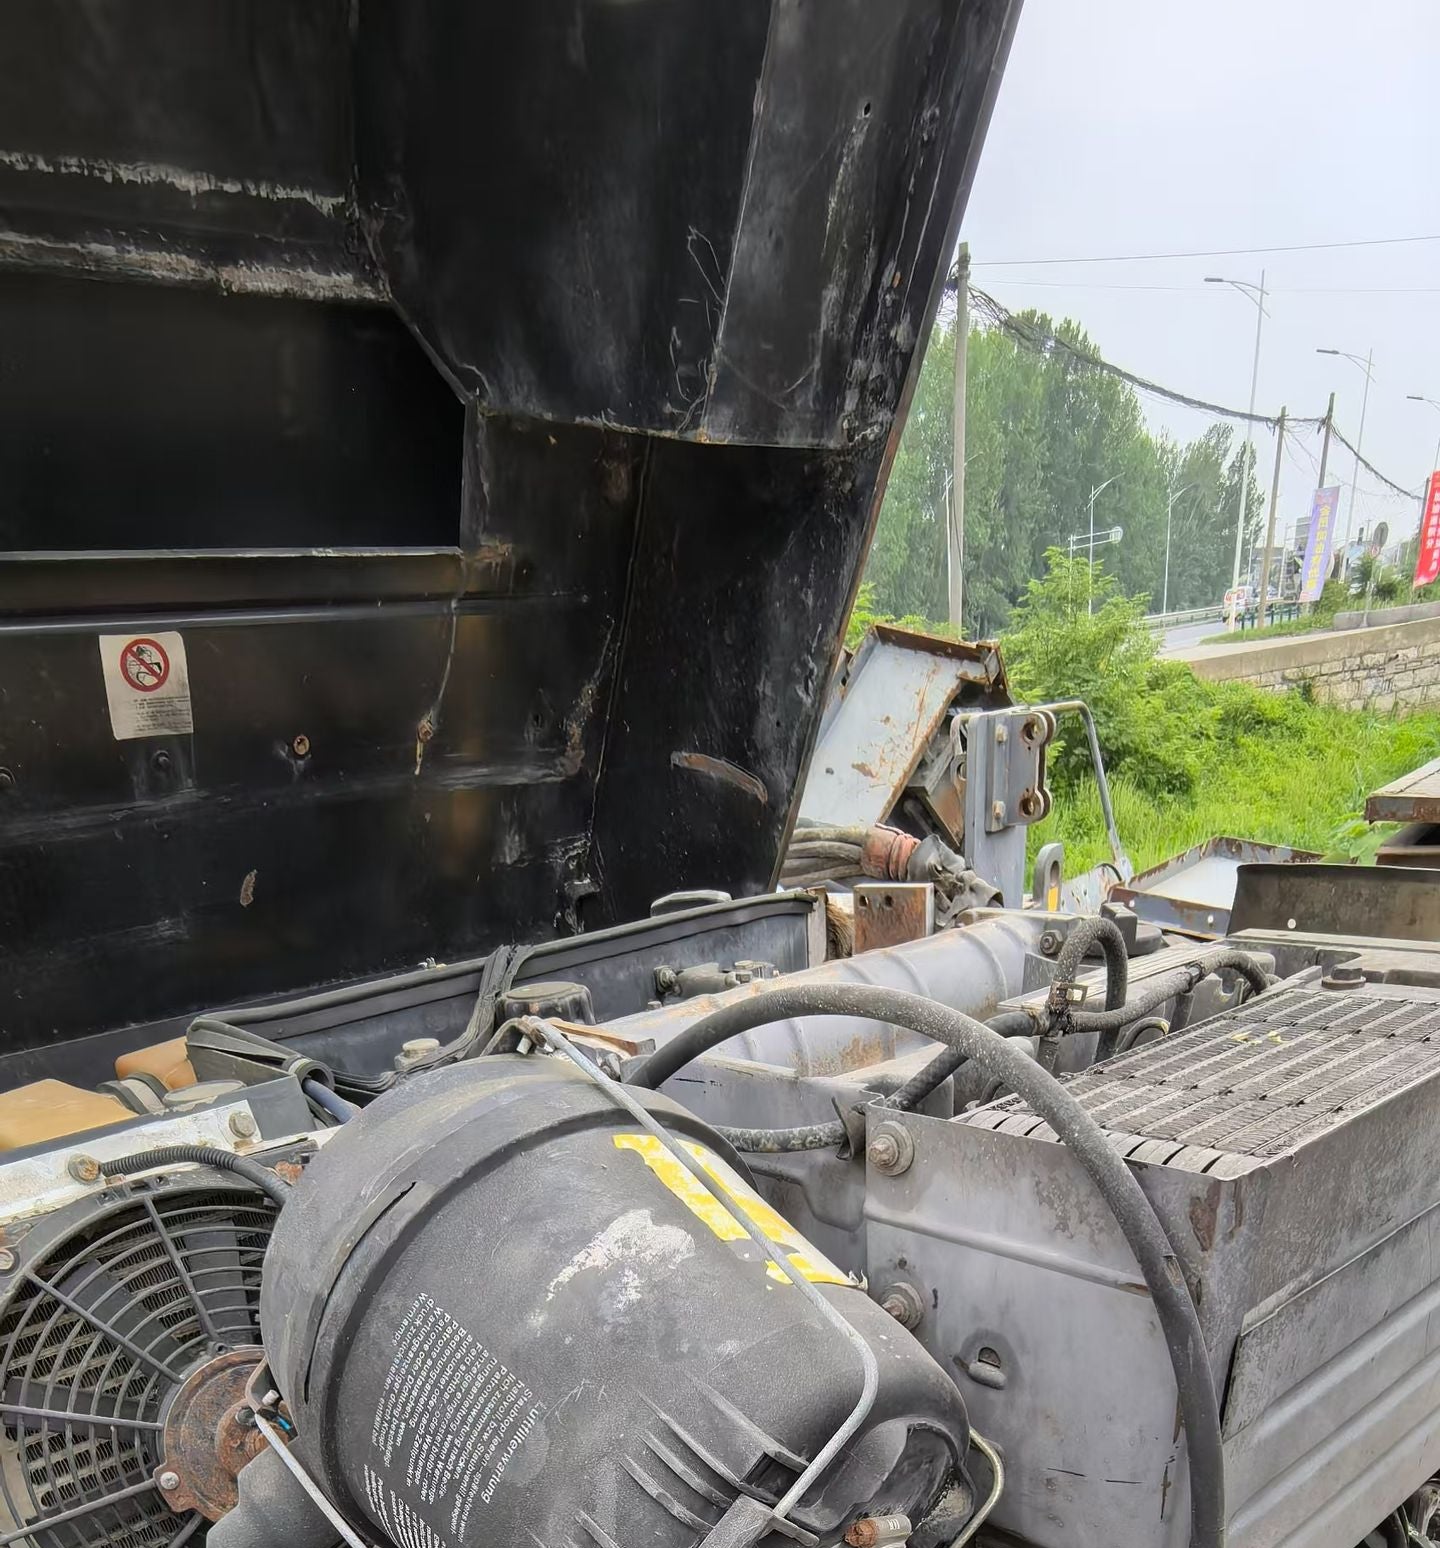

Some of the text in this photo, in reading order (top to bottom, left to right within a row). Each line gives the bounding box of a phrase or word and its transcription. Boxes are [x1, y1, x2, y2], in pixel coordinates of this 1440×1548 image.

[413, 1298, 434, 1327] druck
[421, 1312, 450, 1351] Patrone
[429, 1320, 458, 1358] Patrone
[410, 1350, 425, 1375] oder
[463, 1341, 483, 1366] Feld
[425, 1387, 440, 1412] oder
[427, 1409, 441, 1434] oder
[479, 1419, 497, 1442] bzw.
[480, 1399, 546, 1504] Luftfilterwartung
